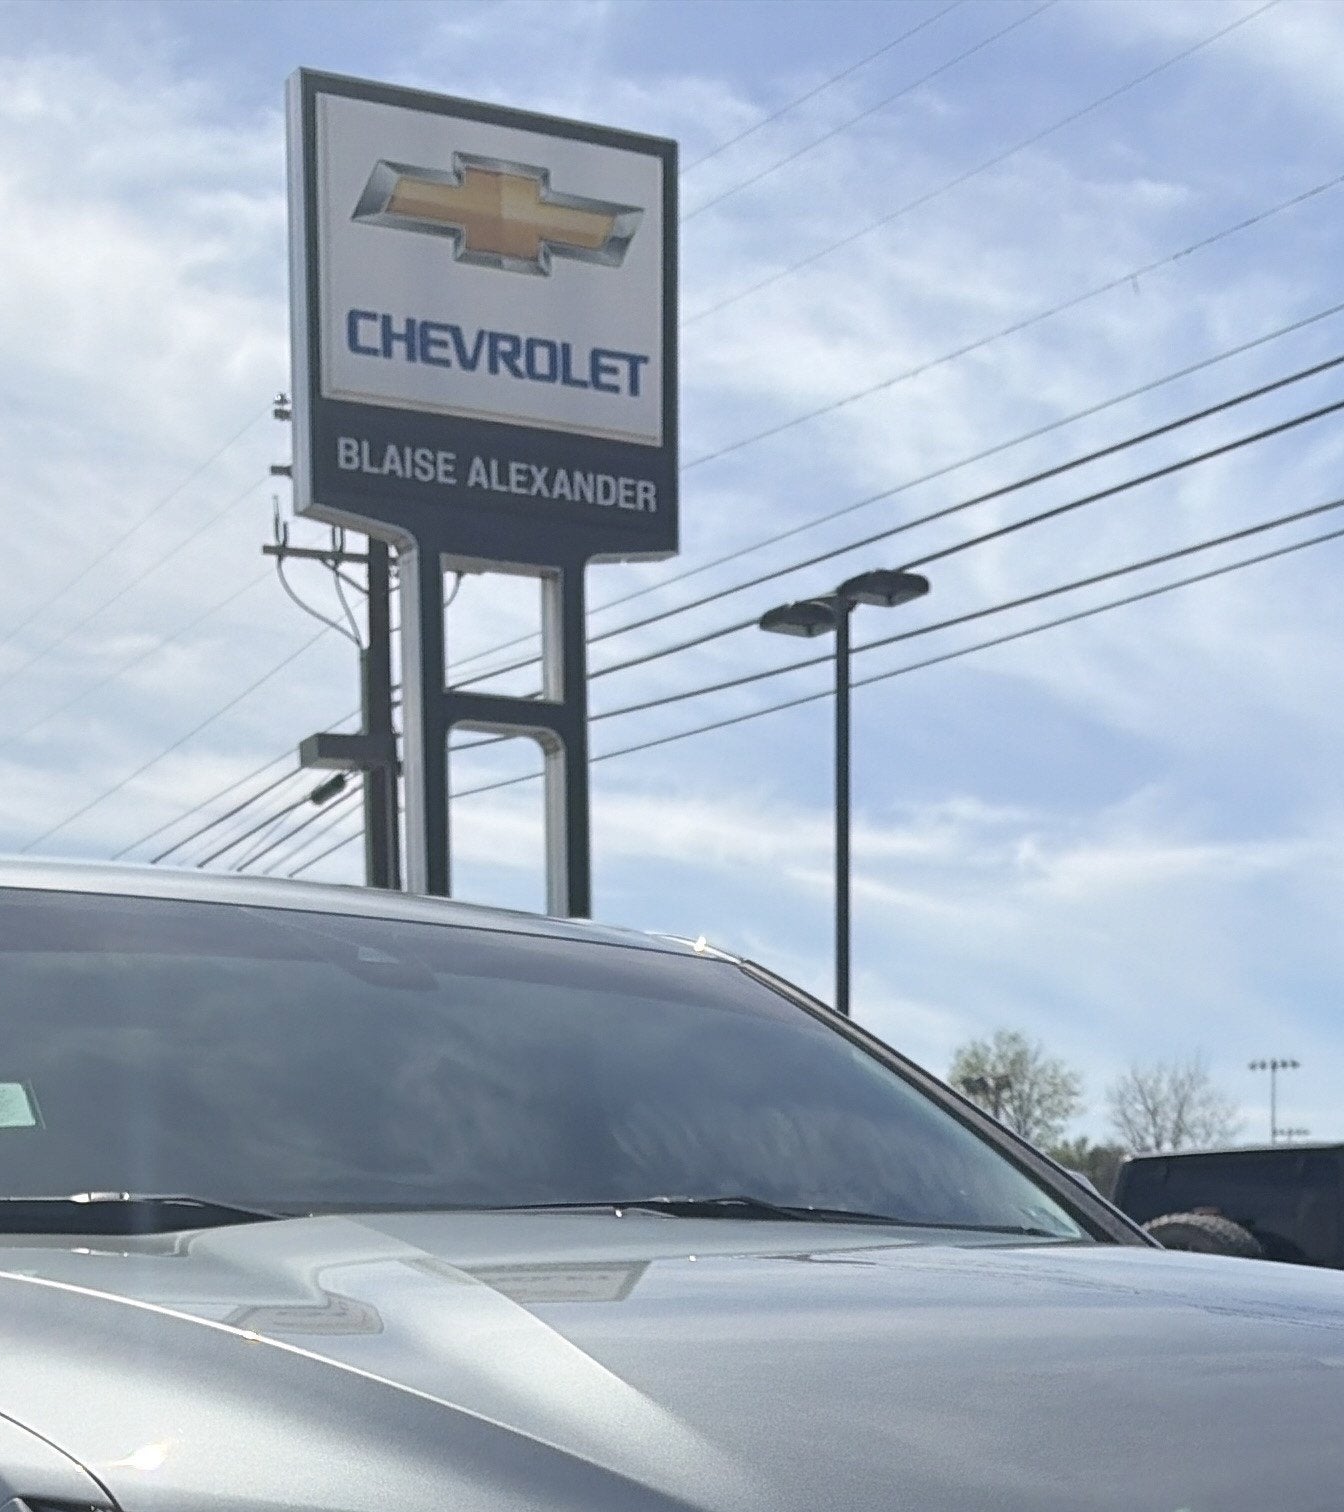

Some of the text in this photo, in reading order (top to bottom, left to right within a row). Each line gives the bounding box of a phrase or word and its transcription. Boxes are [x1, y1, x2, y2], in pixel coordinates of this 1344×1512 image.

[346, 308, 650, 398] CHEVROLET
[337, 436, 657, 513] BLAISE ALEXANDER
